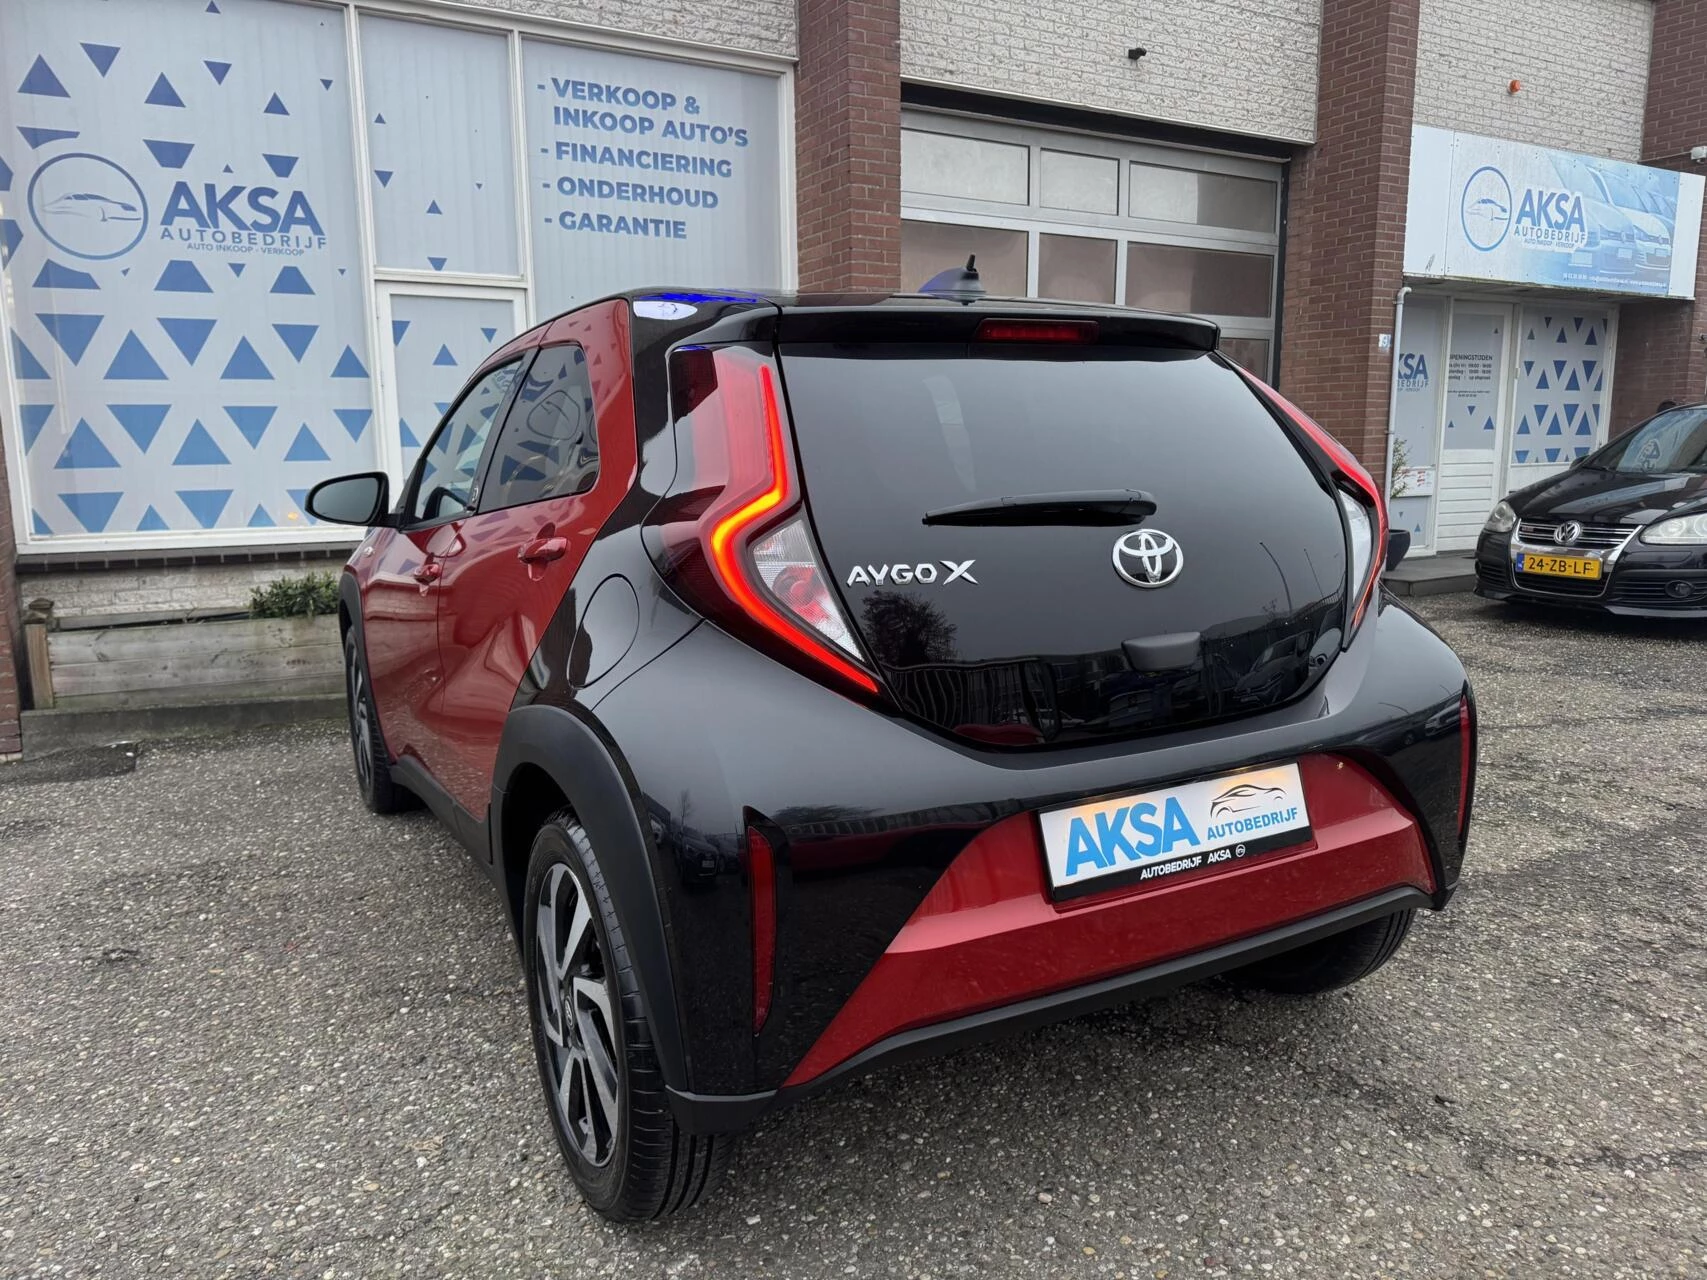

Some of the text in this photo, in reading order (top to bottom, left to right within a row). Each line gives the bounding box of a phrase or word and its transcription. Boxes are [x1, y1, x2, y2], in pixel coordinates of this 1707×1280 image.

[551, 77, 677, 110] VERKOOP
[684, 96, 700, 114] &
[553, 106, 655, 135] INKOOP
[555, 141, 732, 178] FINANCIERING
[160, 181, 325, 236] AKSA
[557, 176, 719, 209] ONDERHOUD
[559, 211, 687, 240] GARANTIE
[1515, 188, 1586, 232] AKSA
[160, 227, 327, 249] AUTOBEDRIJF
[187, 243, 213, 251] AUTO
[216, 244, 253, 253] INKOOP
[261, 247, 305, 256] VERKOOP
[1514, 226, 1586, 244] AUTOBEDRIJF
[846, 559, 979, 587] AYGO X
[1528, 557, 1592, 575] 24-ZB-LF
[1065, 796, 1200, 877] AKSA
[1207, 807, 1298, 841] AUTOBEDRIJF
[1140, 848, 1232, 881] AUTOBEDRIJF AKSA
